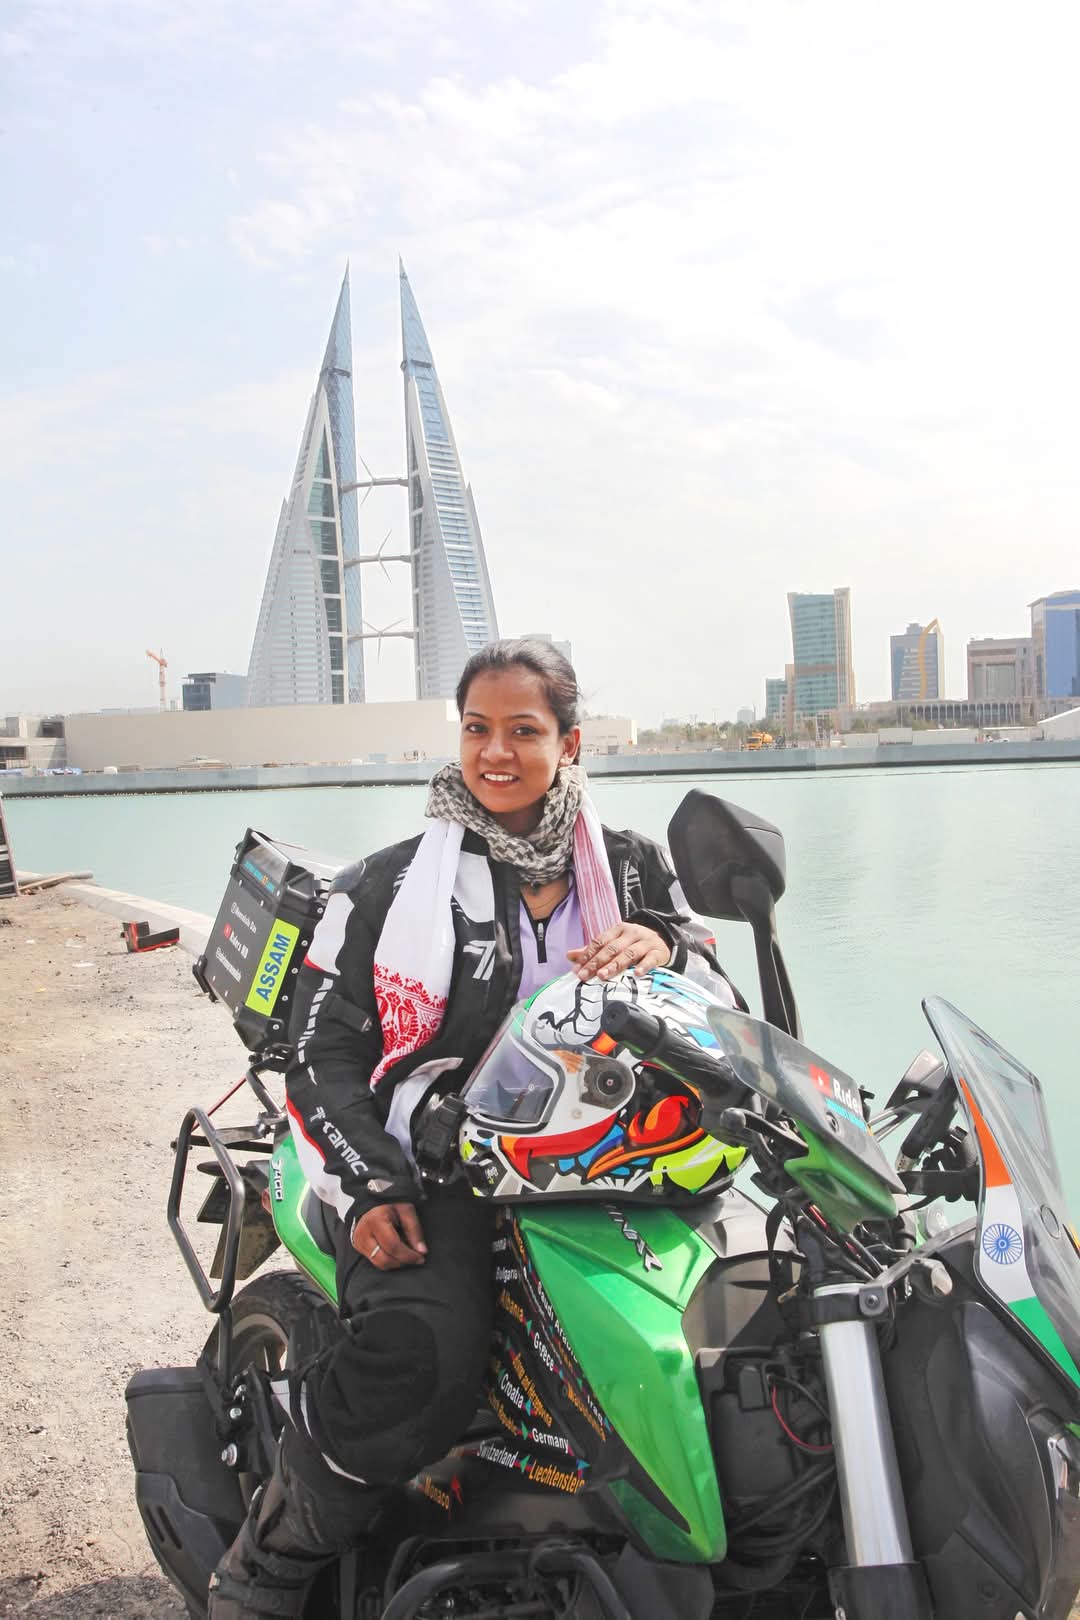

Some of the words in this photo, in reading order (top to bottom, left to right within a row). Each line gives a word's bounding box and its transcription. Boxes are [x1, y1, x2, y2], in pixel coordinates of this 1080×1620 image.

[256, 933, 291, 1002] ASSAM
[537, 1281, 554, 1320] Saudi
[533, 1332, 554, 1371] Greece
[500, 1373, 524, 1409] Croatia
[587, 1394, 604, 1426] Iraq
[477, 1440, 519, 1468] Switzerland
[532, 1428, 569, 1454] Germany
[424, 1477, 450, 1510] Monaco
